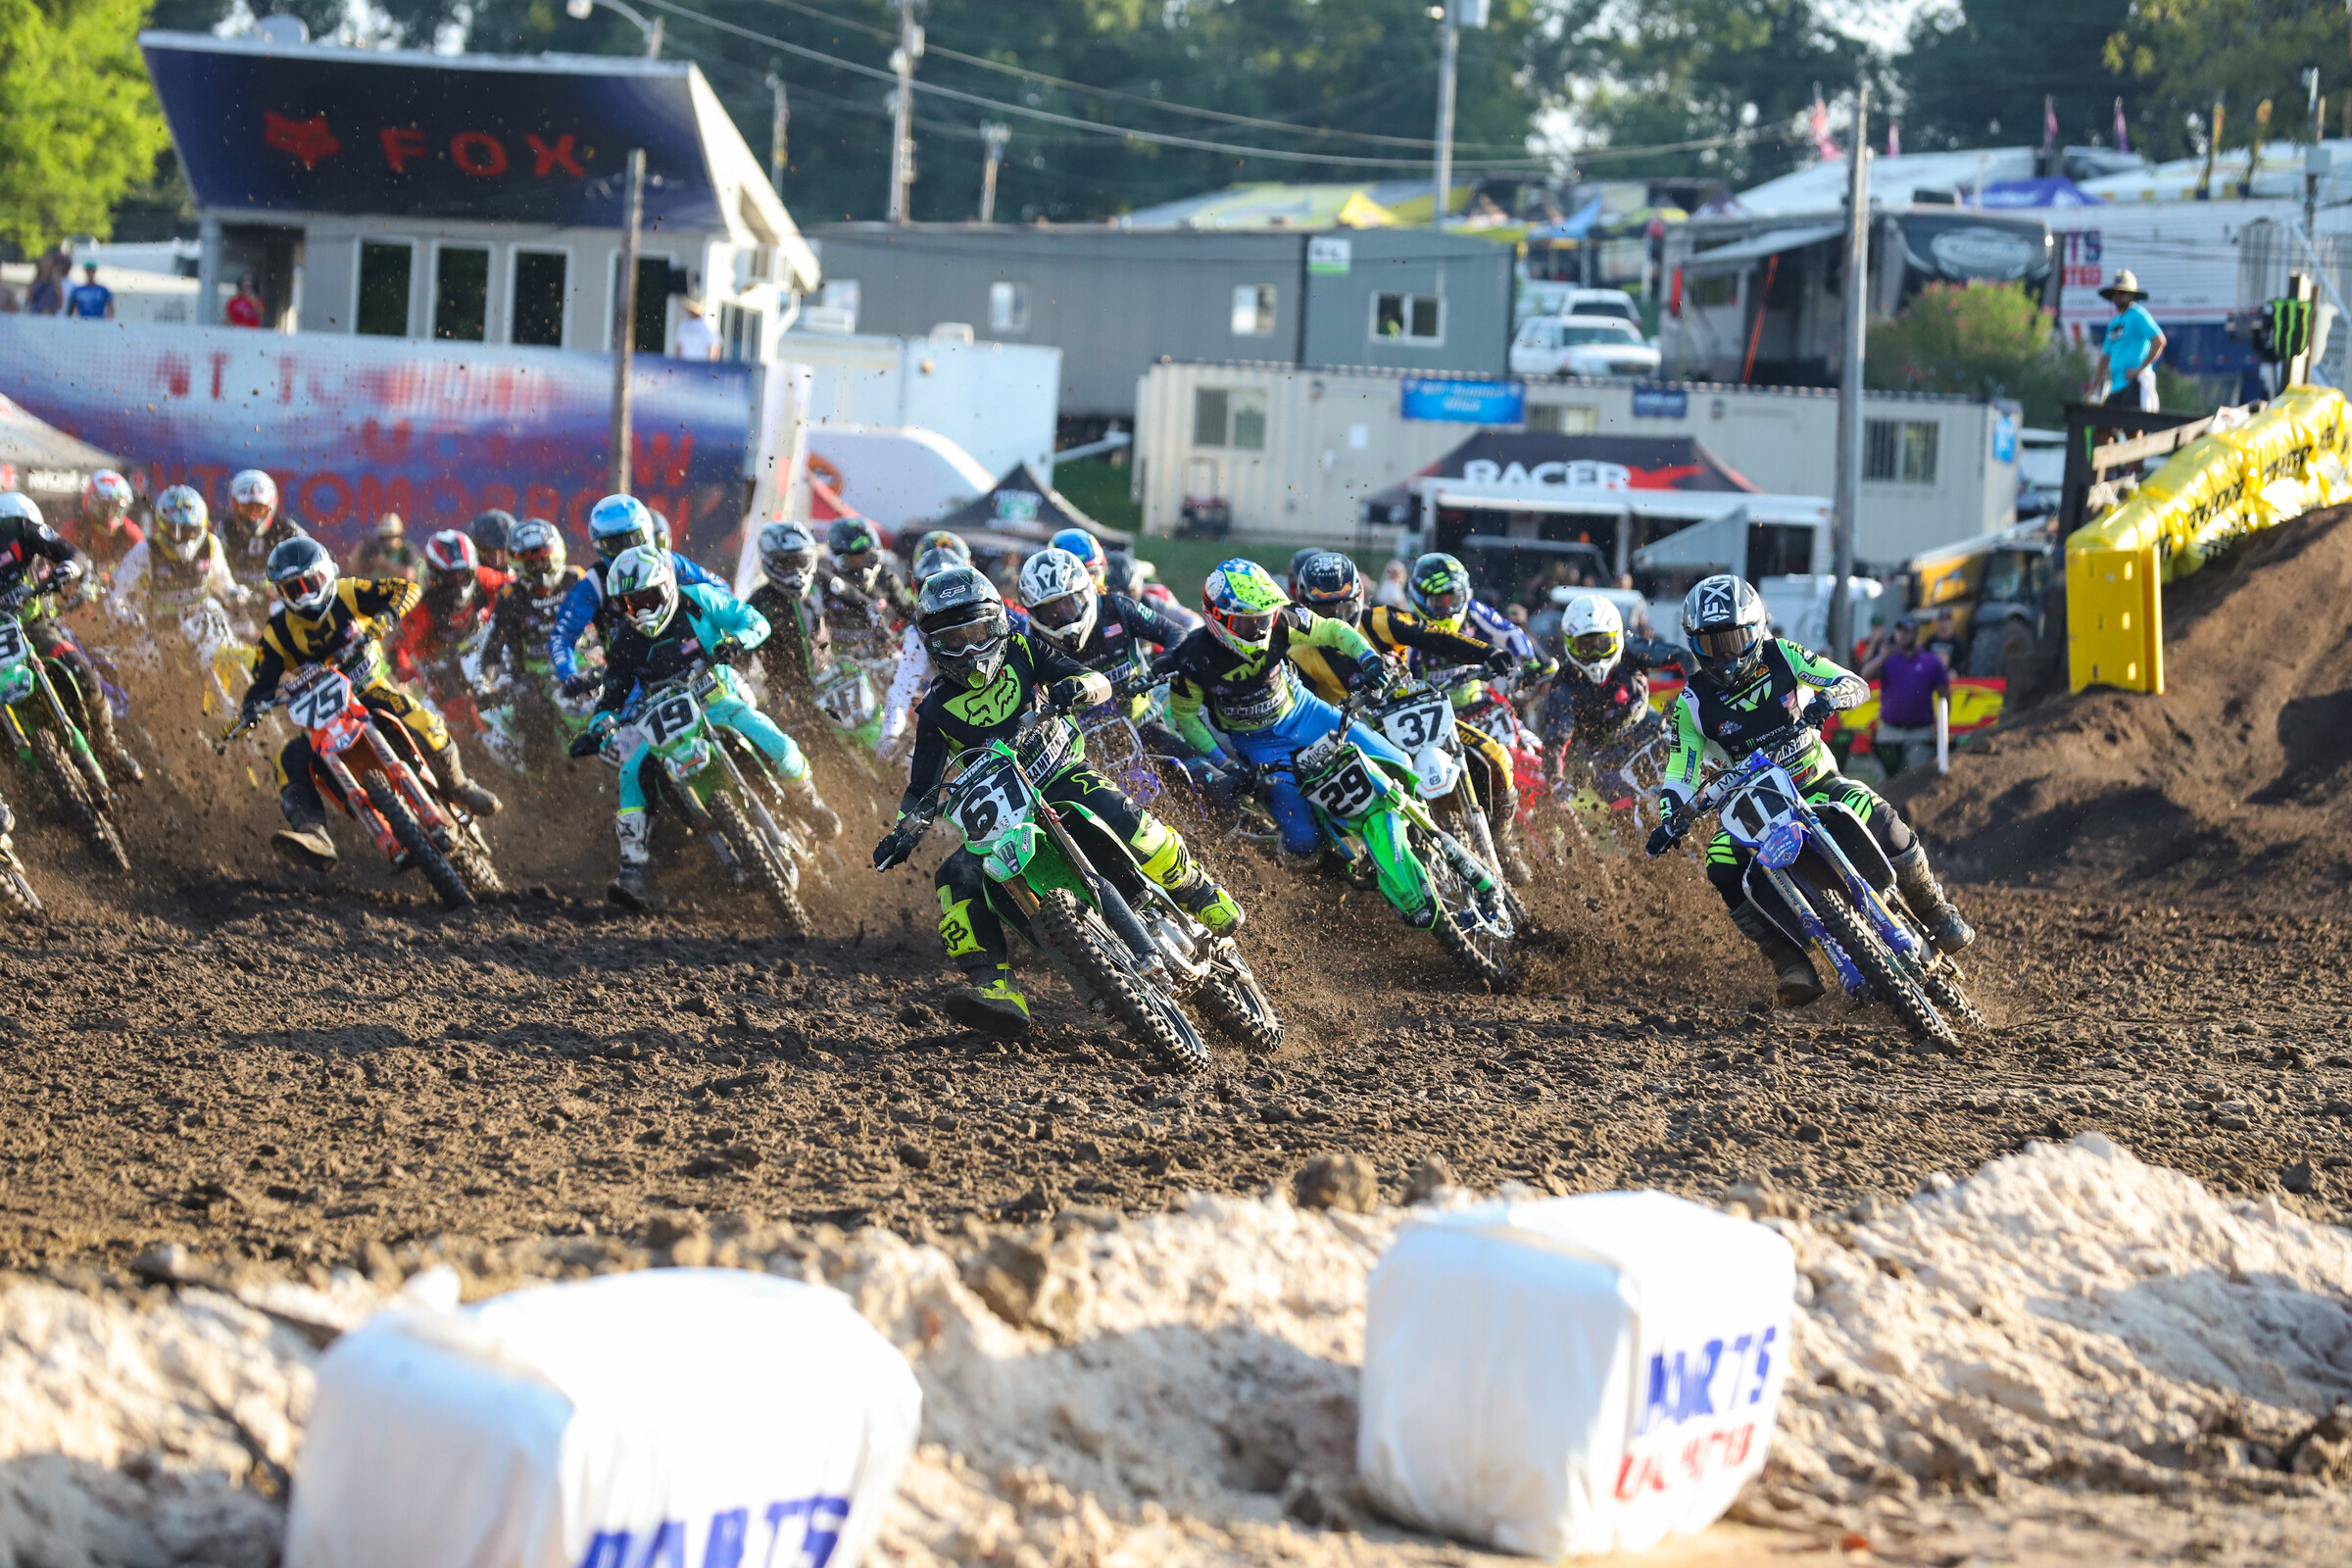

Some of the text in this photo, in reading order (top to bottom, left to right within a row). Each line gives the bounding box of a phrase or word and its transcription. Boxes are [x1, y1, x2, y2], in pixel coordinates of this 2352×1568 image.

[379, 127, 585, 178] FOX
[1463, 459, 1631, 490] RACER
[295, 676, 343, 728] 75
[644, 697, 694, 746] 19
[1397, 705, 1444, 748] 37
[1756, 725, 1787, 743] MONSTER
[960, 765, 1027, 842] 61
[1318, 764, 1373, 817] 29
[1731, 774, 1789, 840] 11
